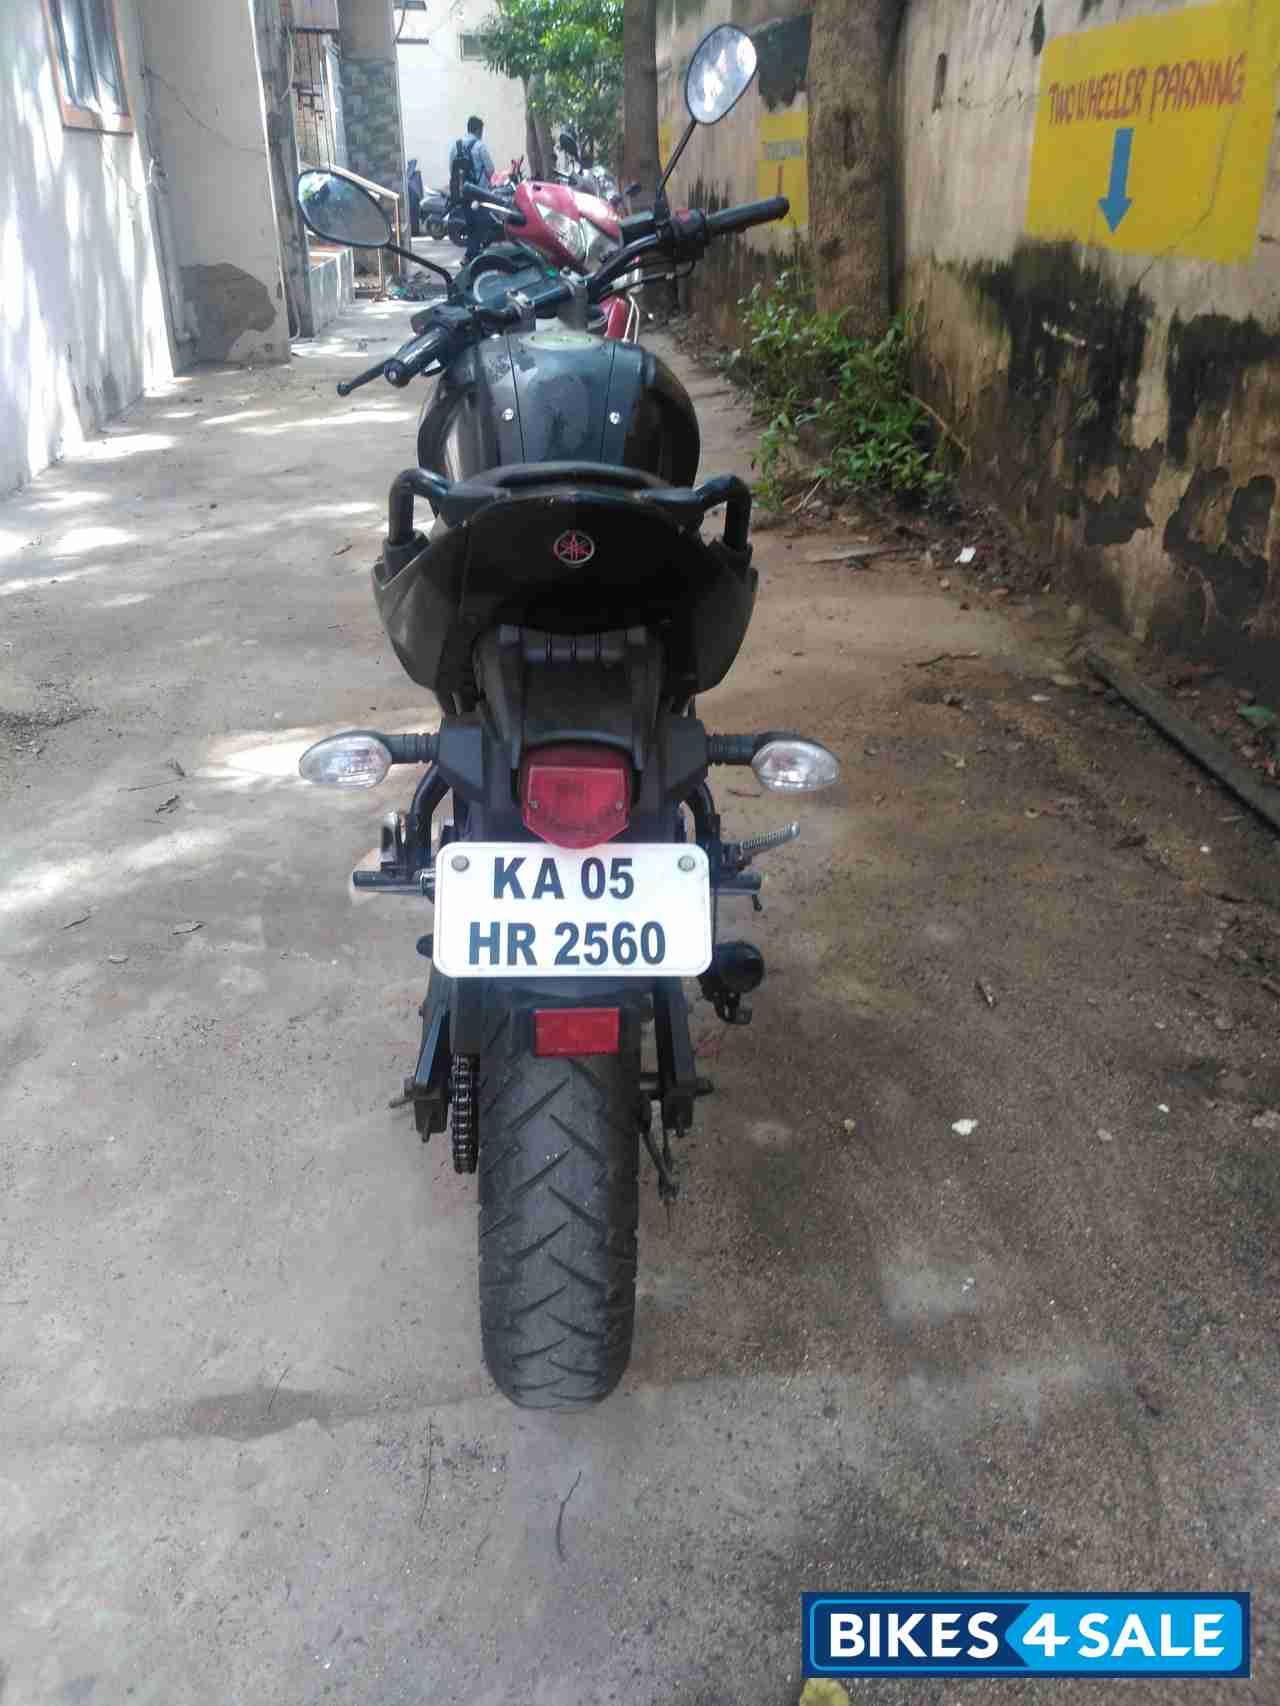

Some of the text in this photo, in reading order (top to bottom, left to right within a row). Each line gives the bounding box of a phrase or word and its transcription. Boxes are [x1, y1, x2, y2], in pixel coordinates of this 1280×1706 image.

[492, 856, 635, 900] KA 05
[468, 920, 667, 966] HR 2560
